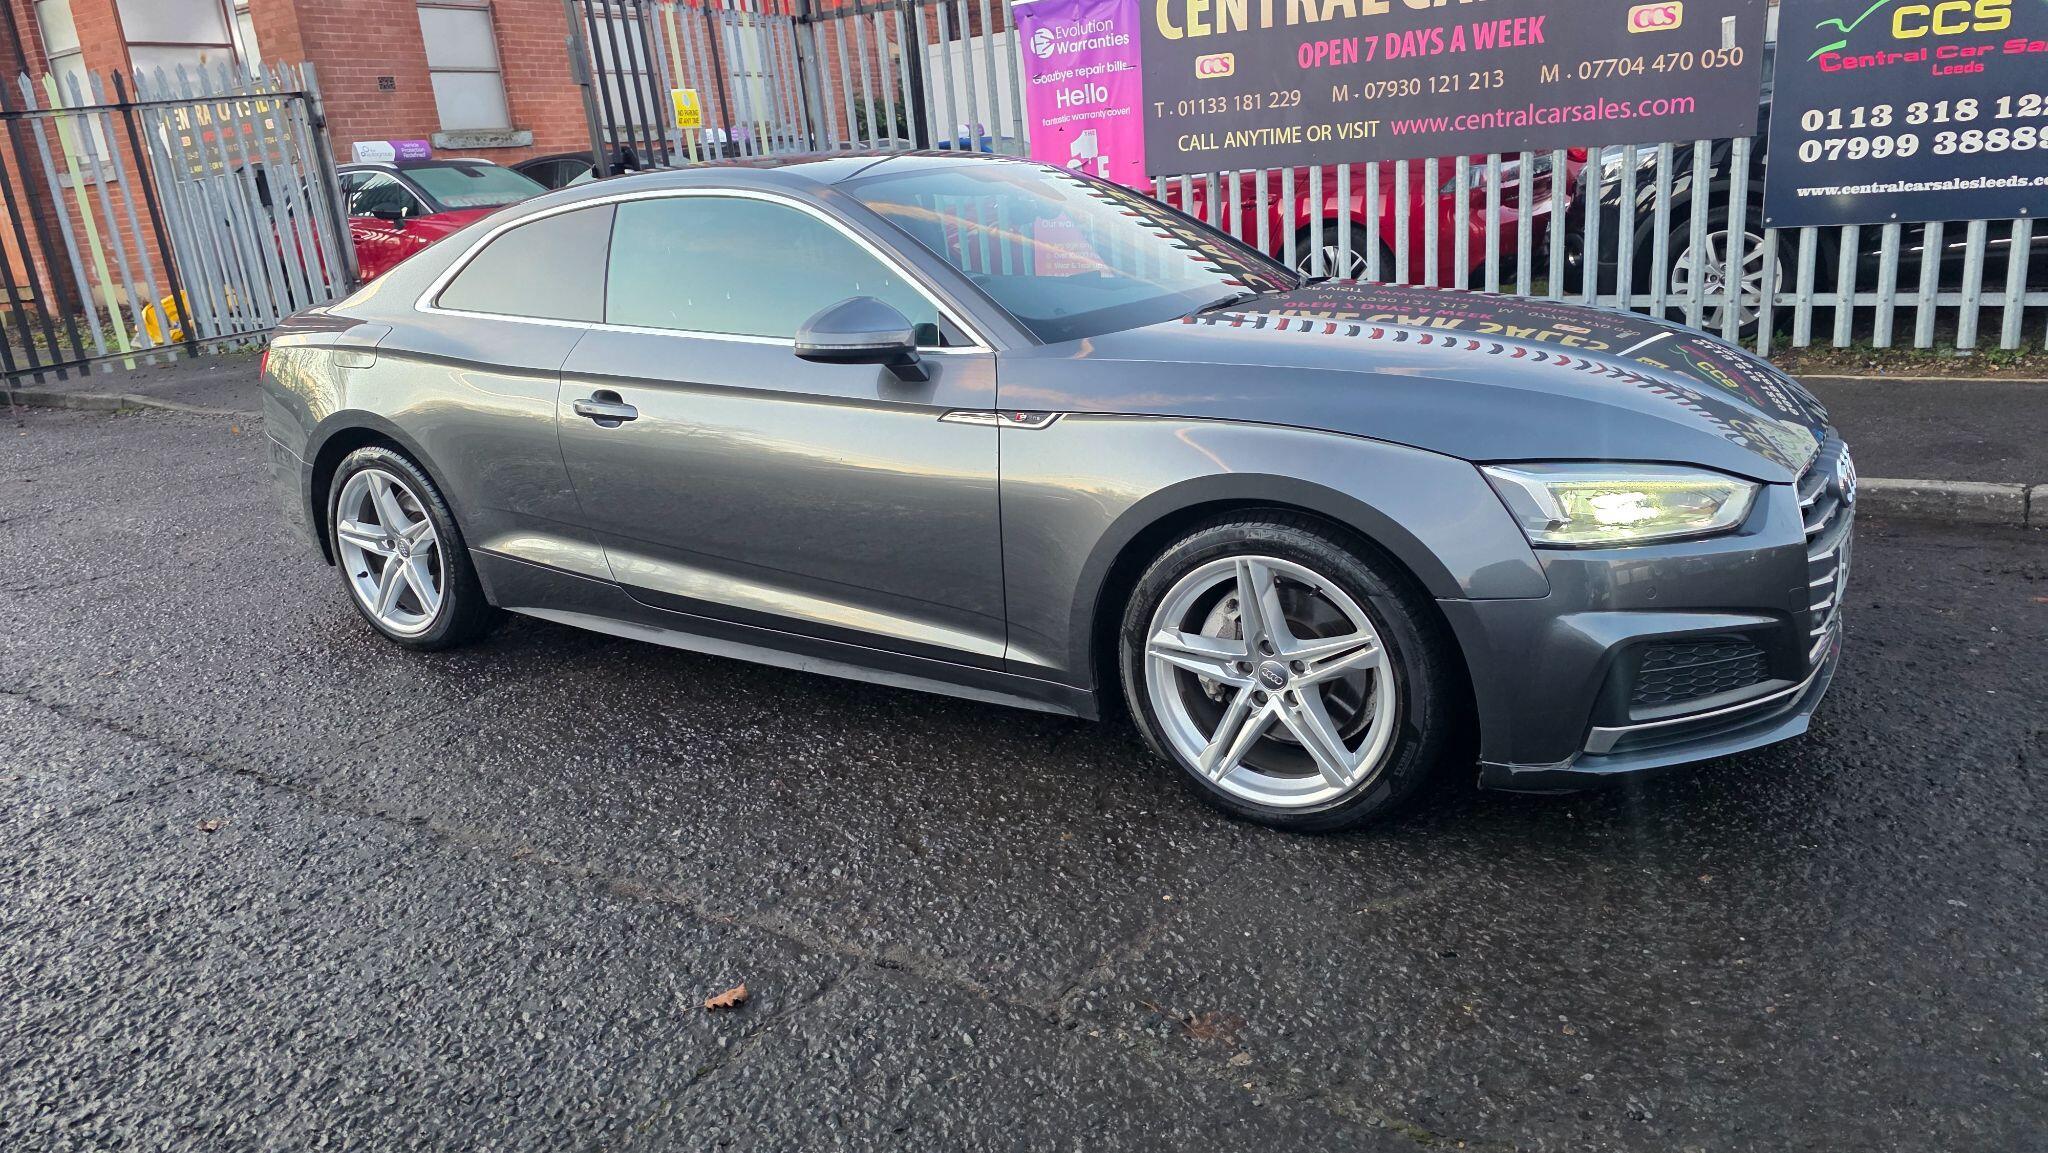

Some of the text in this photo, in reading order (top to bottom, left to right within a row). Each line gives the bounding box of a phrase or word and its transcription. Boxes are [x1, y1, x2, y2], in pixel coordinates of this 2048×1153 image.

[1055, 19, 1114, 39] Evolution
[1892, 0, 2012, 39] CCS
[1056, 32, 1130, 55] Warranties
[1298, 15, 1546, 69] OPEN 7 DAYS A WEEK
[1075, 63, 1106, 78] repair
[1540, 64, 1559, 84] M
[1578, 56, 1645, 80] 07704
[1652, 51, 1694, 73] 470
[1701, 47, 1744, 69] 050
[1819, 47, 1927, 72] Central
[1936, 45, 1994, 59] Car
[1932, 61, 1985, 76] Leeds
[1056, 82, 1109, 109] Hello
[1332, 84, 1349, 103] M
[1364, 78, 1420, 100] 07930
[1428, 74, 1459, 93] 121
[1468, 69, 1505, 90] 213
[1154, 102, 1165, 118] T
[1178, 97, 1227, 117] 01133
[1235, 93, 1262, 112] 181
[1269, 89, 1301, 109] 229
[1390, 96, 1695, 136] www.centralcarsales.com
[1801, 93, 2048, 132] 0113 318 12
[1042, 115, 1071, 127] fantastic
[1072, 110, 1106, 121] warranty
[1178, 120, 1380, 152] CALL ANYTIME OR VISIT
[1798, 133, 1919, 163] 07999
